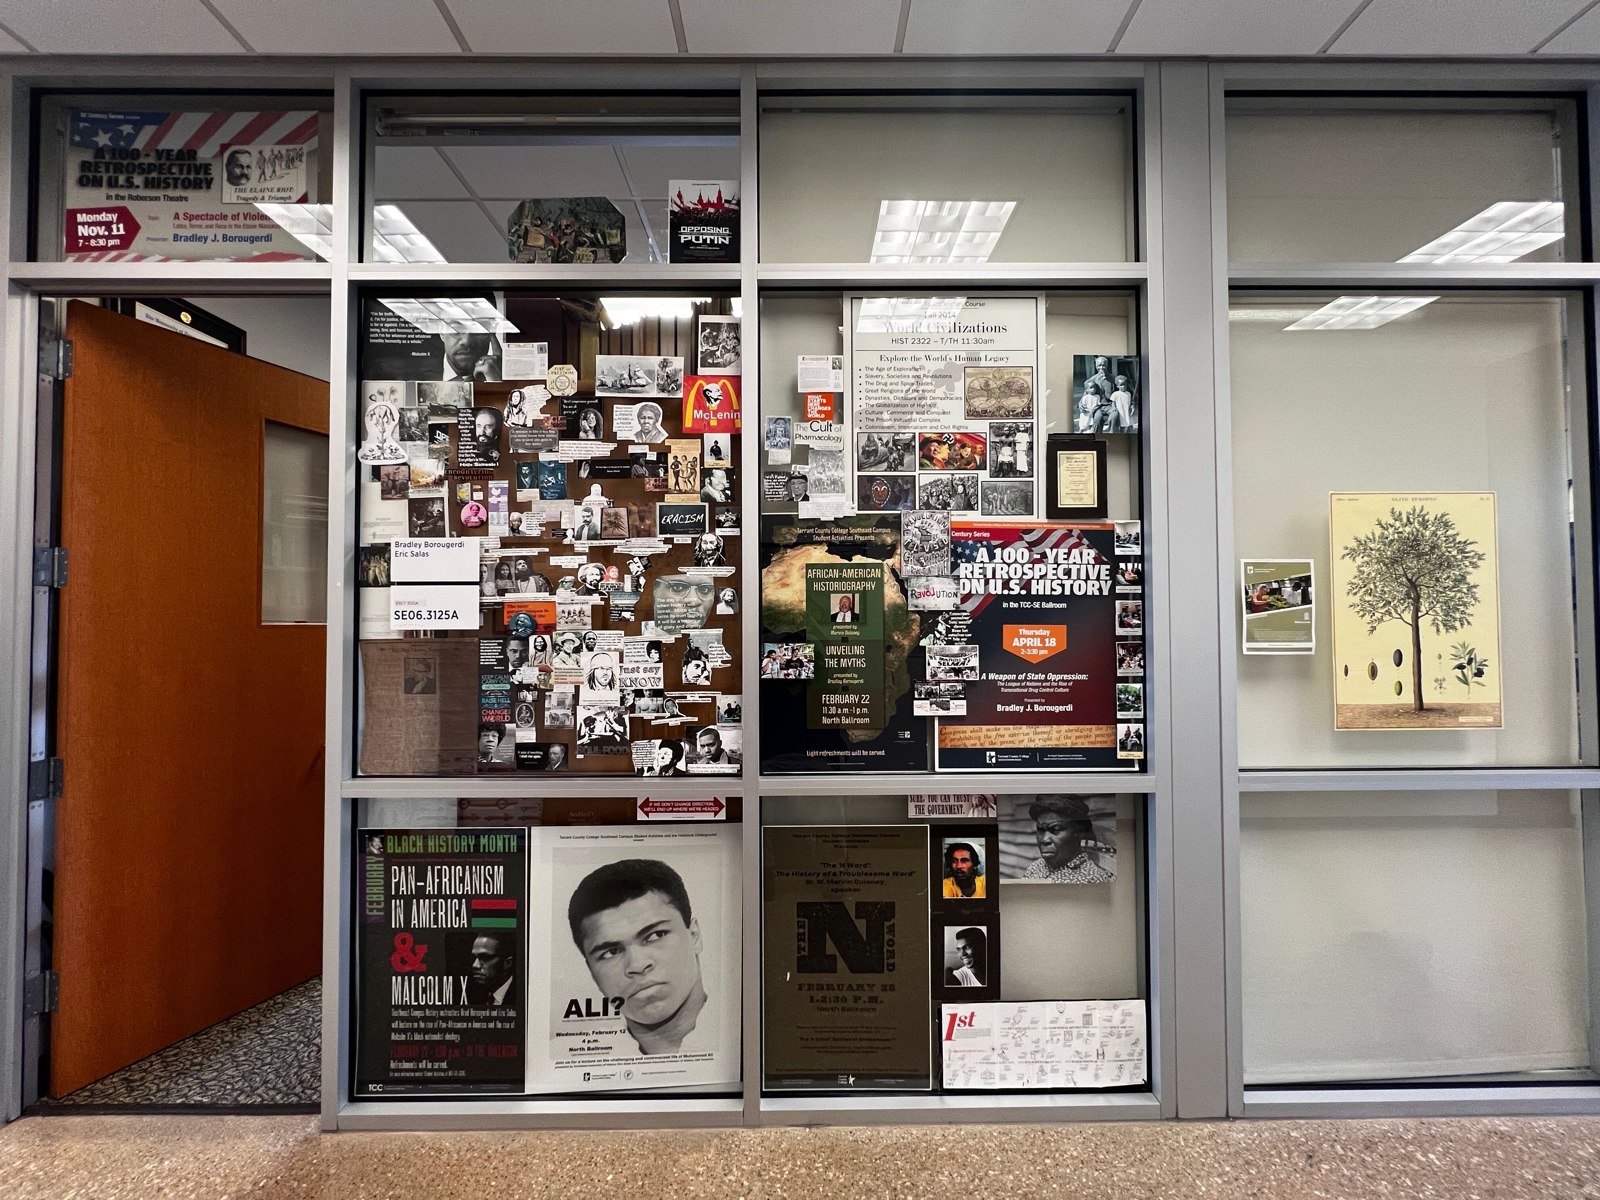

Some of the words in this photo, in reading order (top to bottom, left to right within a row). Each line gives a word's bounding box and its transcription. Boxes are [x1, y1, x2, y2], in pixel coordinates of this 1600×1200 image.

[155, 149, 197, 161] YEAR
[79, 160, 213, 175] RETROSPECTIVE
[78, 175, 103, 187] ON
[107, 176, 140, 188] U.S.
[143, 177, 214, 189] HISTORY
[115, 193, 126, 201] the
[76, 212, 118, 223] Monday
[173, 213, 181, 221] A
[182, 212, 229, 222] Spectacle
[230, 212, 240, 221] of
[77, 225, 109, 236] Nov.
[111, 223, 126, 235] 11
[107, 239, 121, 247] pm
[172, 233, 209, 244] Bradley
[211, 234, 220, 243] J.
[222, 233, 273, 244] Borougerdi
[680, 235, 730, 244] PUTIN
[926, 322, 1008, 333] Civilizations
[891, 337, 909, 345] HIST
[910, 337, 931, 345] 2322
[940, 337, 959, 345] T/TH
[960, 337, 995, 345] 11:30am
[879, 354, 909, 363] Explore
[910, 354, 923, 362] the
[924, 354, 953, 362] World's
[954, 354, 982, 362] Human
[984, 354, 1010, 363] Legacy
[693, 409, 741, 420] McLenin
[809, 421, 833, 432] Cult
[795, 434, 842, 443] Pharmacology
[661, 513, 705, 524] ERACISM
[951, 531, 971, 539] Century
[394, 541, 422, 549] Bradley
[423, 541, 465, 549] Borougerdi
[394, 550, 409, 558] Eric
[410, 550, 429, 558] Salas
[975, 548, 990, 563] A
[993, 548, 1030, 563] 100
[1048, 549, 1095, 564] YEAR
[807, 568, 881, 578] AFRICAN-AMERICAN
[959, 563, 1111, 580] RETROSPECTIVE
[813, 581, 876, 591] HISTORIOGRAPHY
[988, 580, 1026, 595] U.S.
[1031, 580, 1113, 596] HISTORY
[1020, 601, 1041, 609] TCC-SE
[393, 609, 459, 620] SE06.3125A
[1018, 629, 1051, 637] Thursday
[1012, 638, 1043, 646] APRIL
[1044, 638, 1057, 646] 18
[825, 645, 865, 656] UNVEILING
[824, 658, 838, 668] THE
[839, 658, 866, 668] MYTHS
[619, 665, 641, 675] Just
[642, 666, 661, 676] say
[619, 677, 662, 688] KNOW
[988, 673, 1017, 681] Weapon
[1047, 673, 1089, 681] Oppression:
[821, 694, 860, 704] FEBRUARY
[860, 694, 870, 704] 22
[996, 704, 1024, 713] Bradley
[1025, 704, 1033, 712] J.
[1033, 704, 1073, 713] Borougerdi
[822, 716, 841, 724] North
[841, 716, 870, 724] Ballroom
[914, 804, 926, 815] THE
[927, 804, 966, 815] GOVERNMENT.
[387, 835, 424, 853] BLACK
[428, 835, 476, 853] HISTORY
[480, 835, 518, 853] MONTH
[366, 855, 385, 916] FEBRUARY
[391, 865, 504, 896] PAN-AFRICANISM
[391, 899, 404, 929] IN
[411, 898, 468, 929] AMERICA
[796, 901, 896, 974] N
[391, 931, 428, 973] &
[391, 975, 454, 1006] MALCOLM
[460, 975, 469, 1006] X
[797, 983, 877, 992] FEBRUARY
[880, 983, 896, 992] 25
[563, 996, 626, 1019] ALI?
[943, 1011, 976, 1042] 1st
[555, 1030, 591, 1038] Wednesday,
[591, 1029, 618, 1037] February
[368, 1083, 384, 1091] TCC
